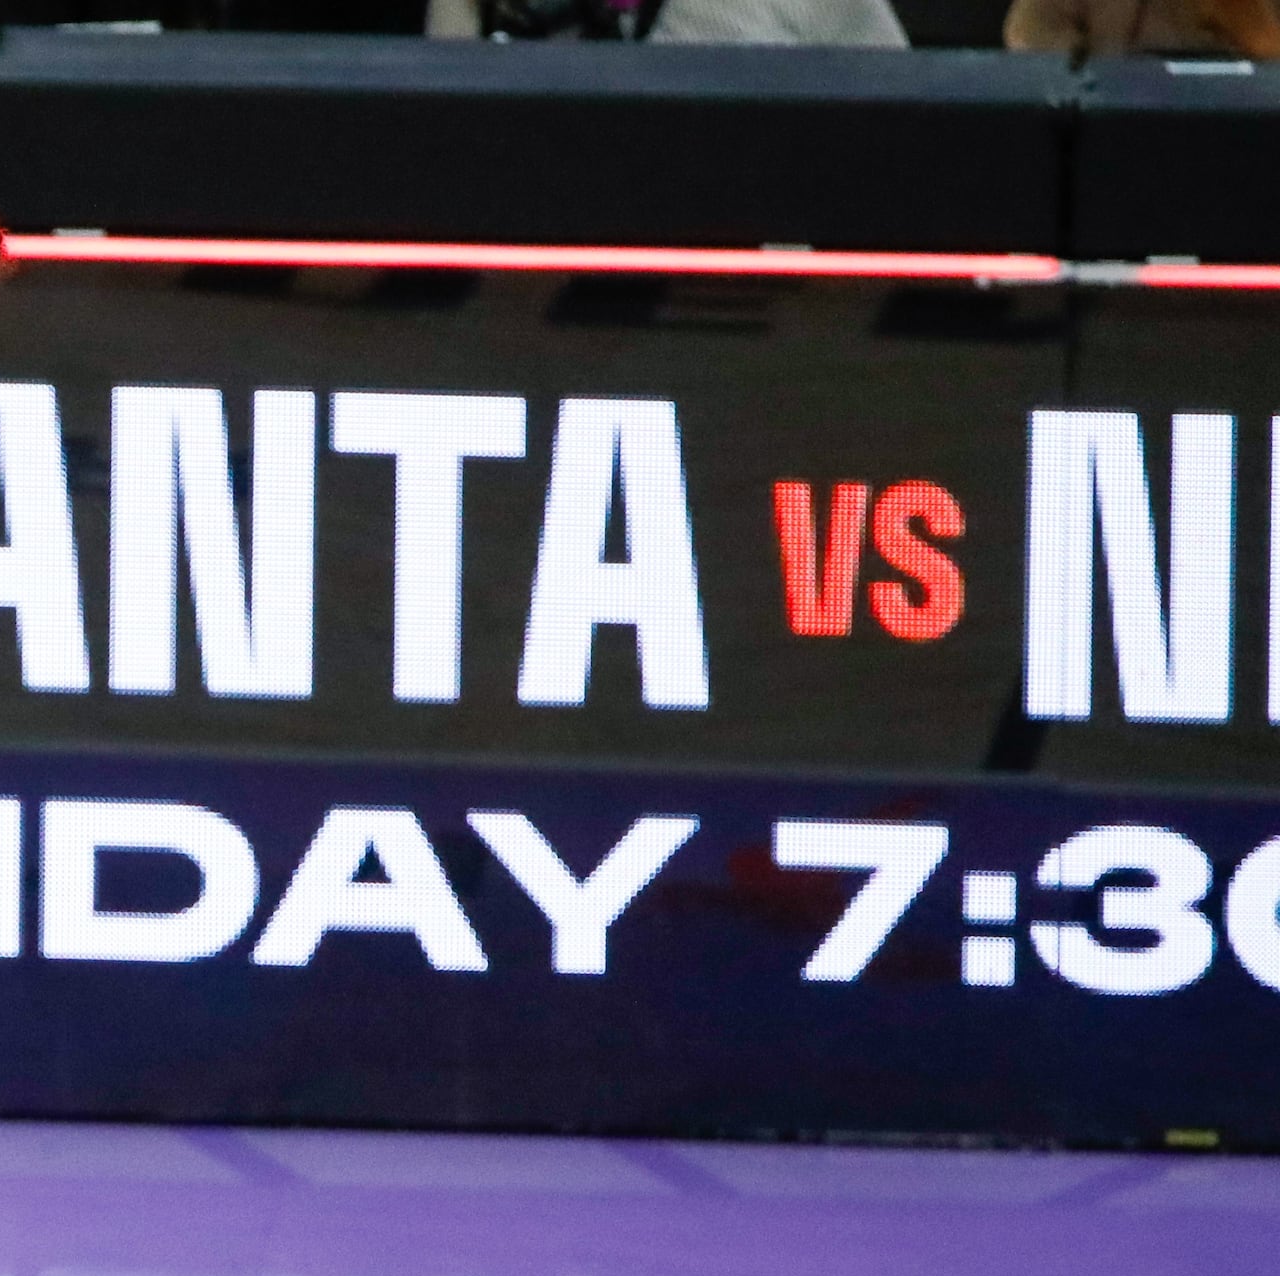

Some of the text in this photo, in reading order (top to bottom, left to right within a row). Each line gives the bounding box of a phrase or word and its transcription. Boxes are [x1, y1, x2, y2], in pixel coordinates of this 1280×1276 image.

[773, 479, 967, 644] VS
[1024, 408, 1280, 727] N
[772, 818, 1280, 996] 7:3
